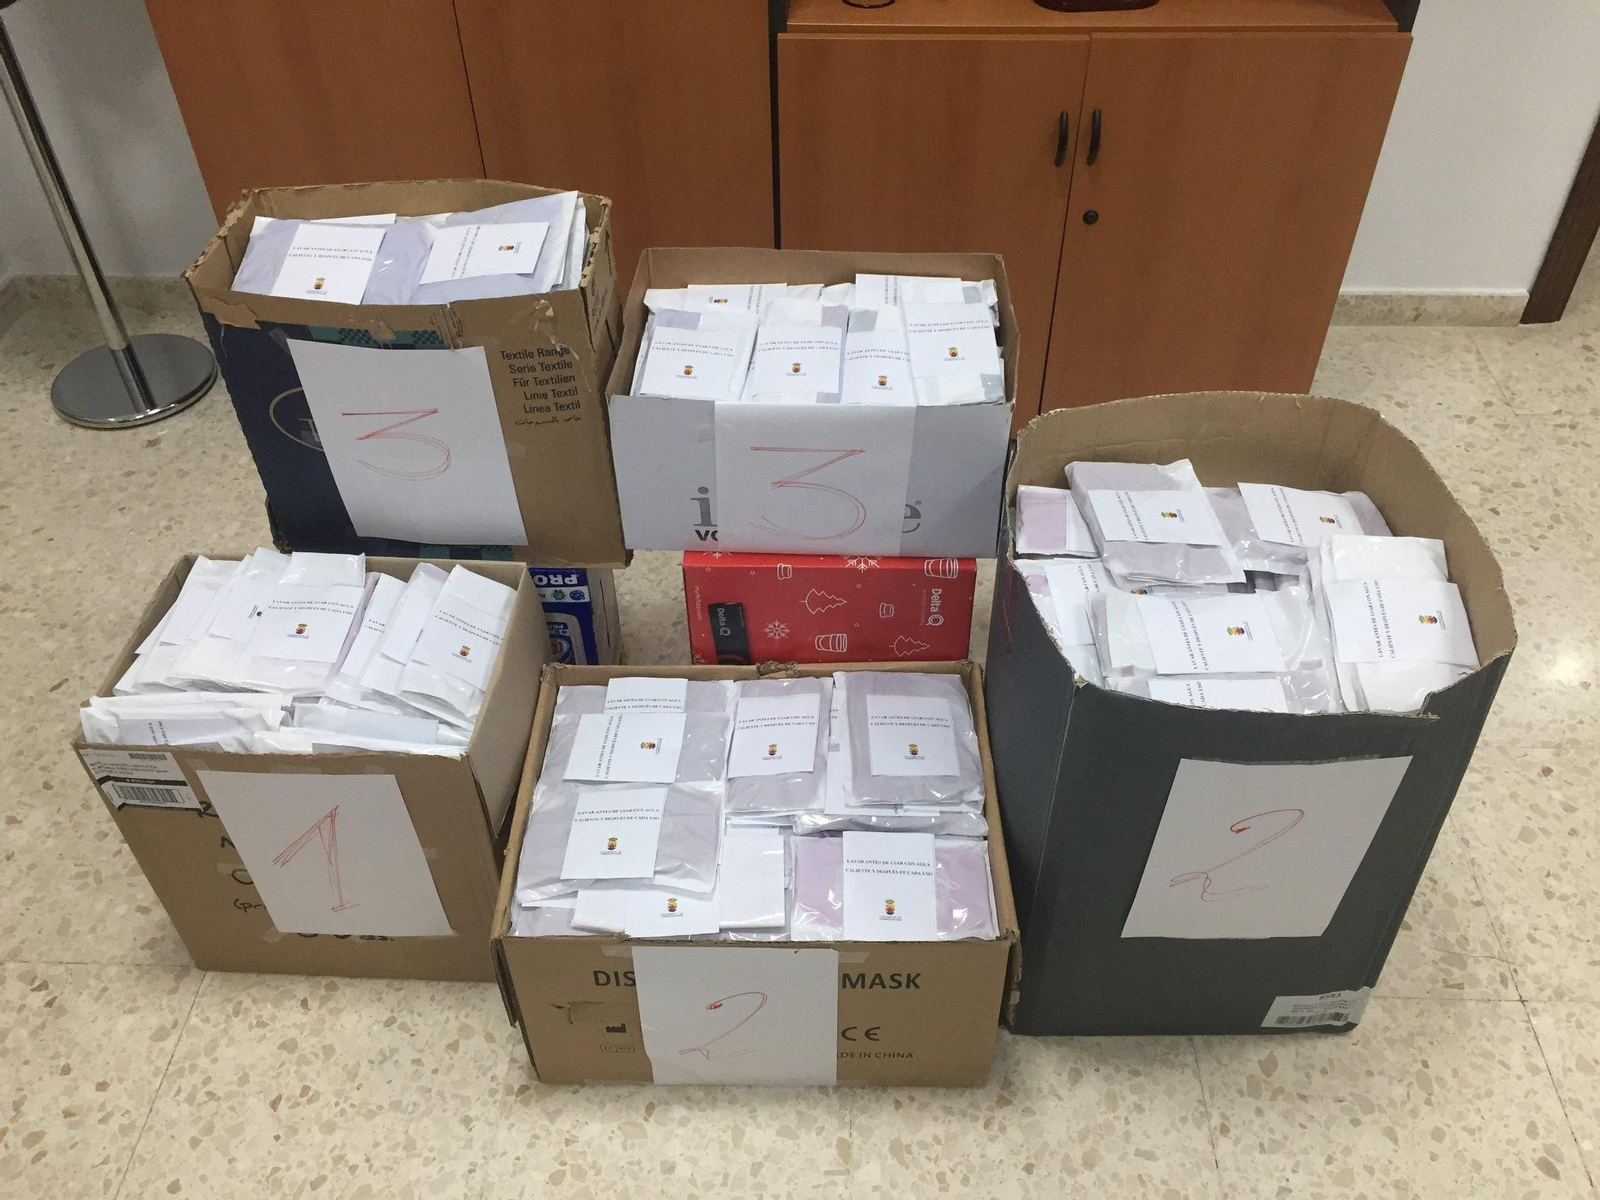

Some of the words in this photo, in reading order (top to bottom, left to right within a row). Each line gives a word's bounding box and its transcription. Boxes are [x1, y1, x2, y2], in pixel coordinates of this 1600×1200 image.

[500, 350, 534, 360] Textile
[537, 347, 571, 358] Range
[509, 364, 536, 374] Serie
[538, 360, 573, 372] Textile
[513, 378, 530, 387] Für
[533, 375, 575, 386] Textilien
[524, 391, 548, 400] Linie
[550, 387, 578, 398] Textil
[524, 404, 550, 413] Linea
[554, 400, 581, 411] Textil
[342, 408, 451, 480] 3
[749, 446, 866, 540] 3
[930, 589, 942, 612] Delta
[717, 608, 726, 626] Delta
[926, 614, 944, 626] Q
[272, 805, 360, 913] 1
[1170, 809, 1305, 901] 2
[842, 973, 921, 989] MASK
[679, 991, 767, 1061] 2
